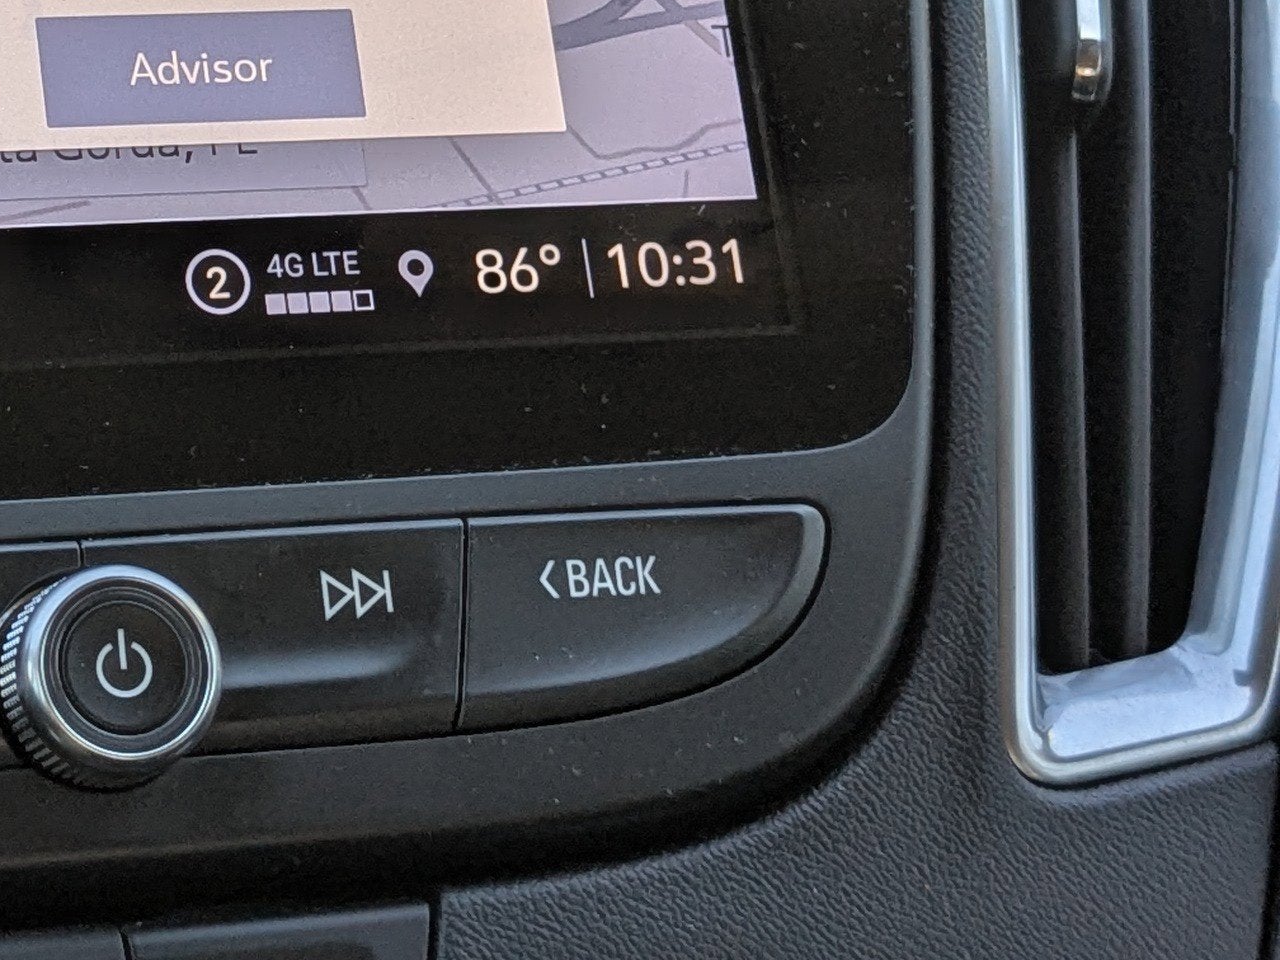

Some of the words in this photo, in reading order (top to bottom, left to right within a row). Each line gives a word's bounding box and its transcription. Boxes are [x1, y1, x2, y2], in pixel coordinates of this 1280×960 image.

[130, 50, 273, 86] Advisor
[266, 252, 304, 278] 4G
[311, 250, 361, 277] LTE
[607, 238, 744, 289] 10:31
[206, 266, 231, 299] 2
[565, 555, 661, 598] BACK
